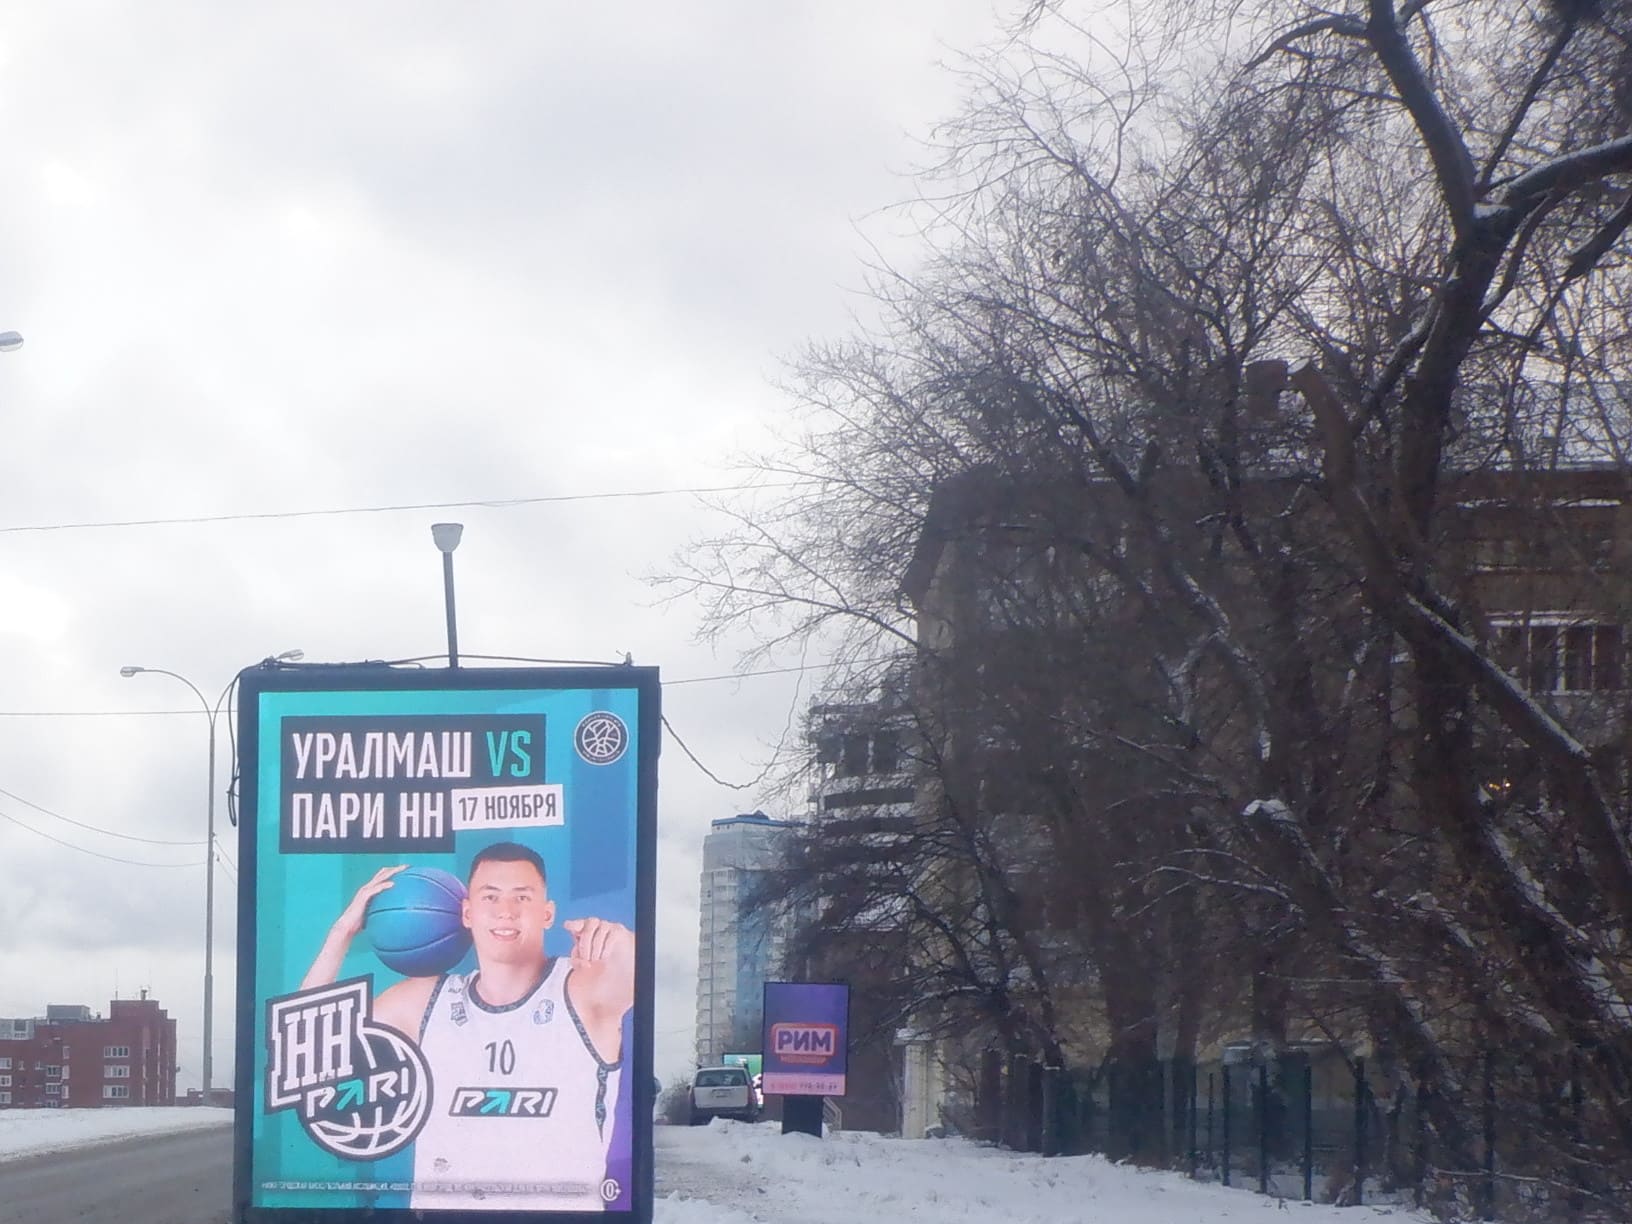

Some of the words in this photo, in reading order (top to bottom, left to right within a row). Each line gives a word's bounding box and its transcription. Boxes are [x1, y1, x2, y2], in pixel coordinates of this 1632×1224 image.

[292, 731, 472, 780] УРАЛМАШ
[486, 730, 532, 778] VS
[291, 792, 384, 839] ПАРИ
[399, 791, 444, 839] НН
[458, 796, 476, 821] 17
[485, 792, 557, 821] НОЯБРЯ
[484, 1039, 516, 1075] 10
[778, 1031, 831, 1052] РИМ
[306, 1068, 410, 1118] PARI
[452, 1090, 553, 1115] PARI
